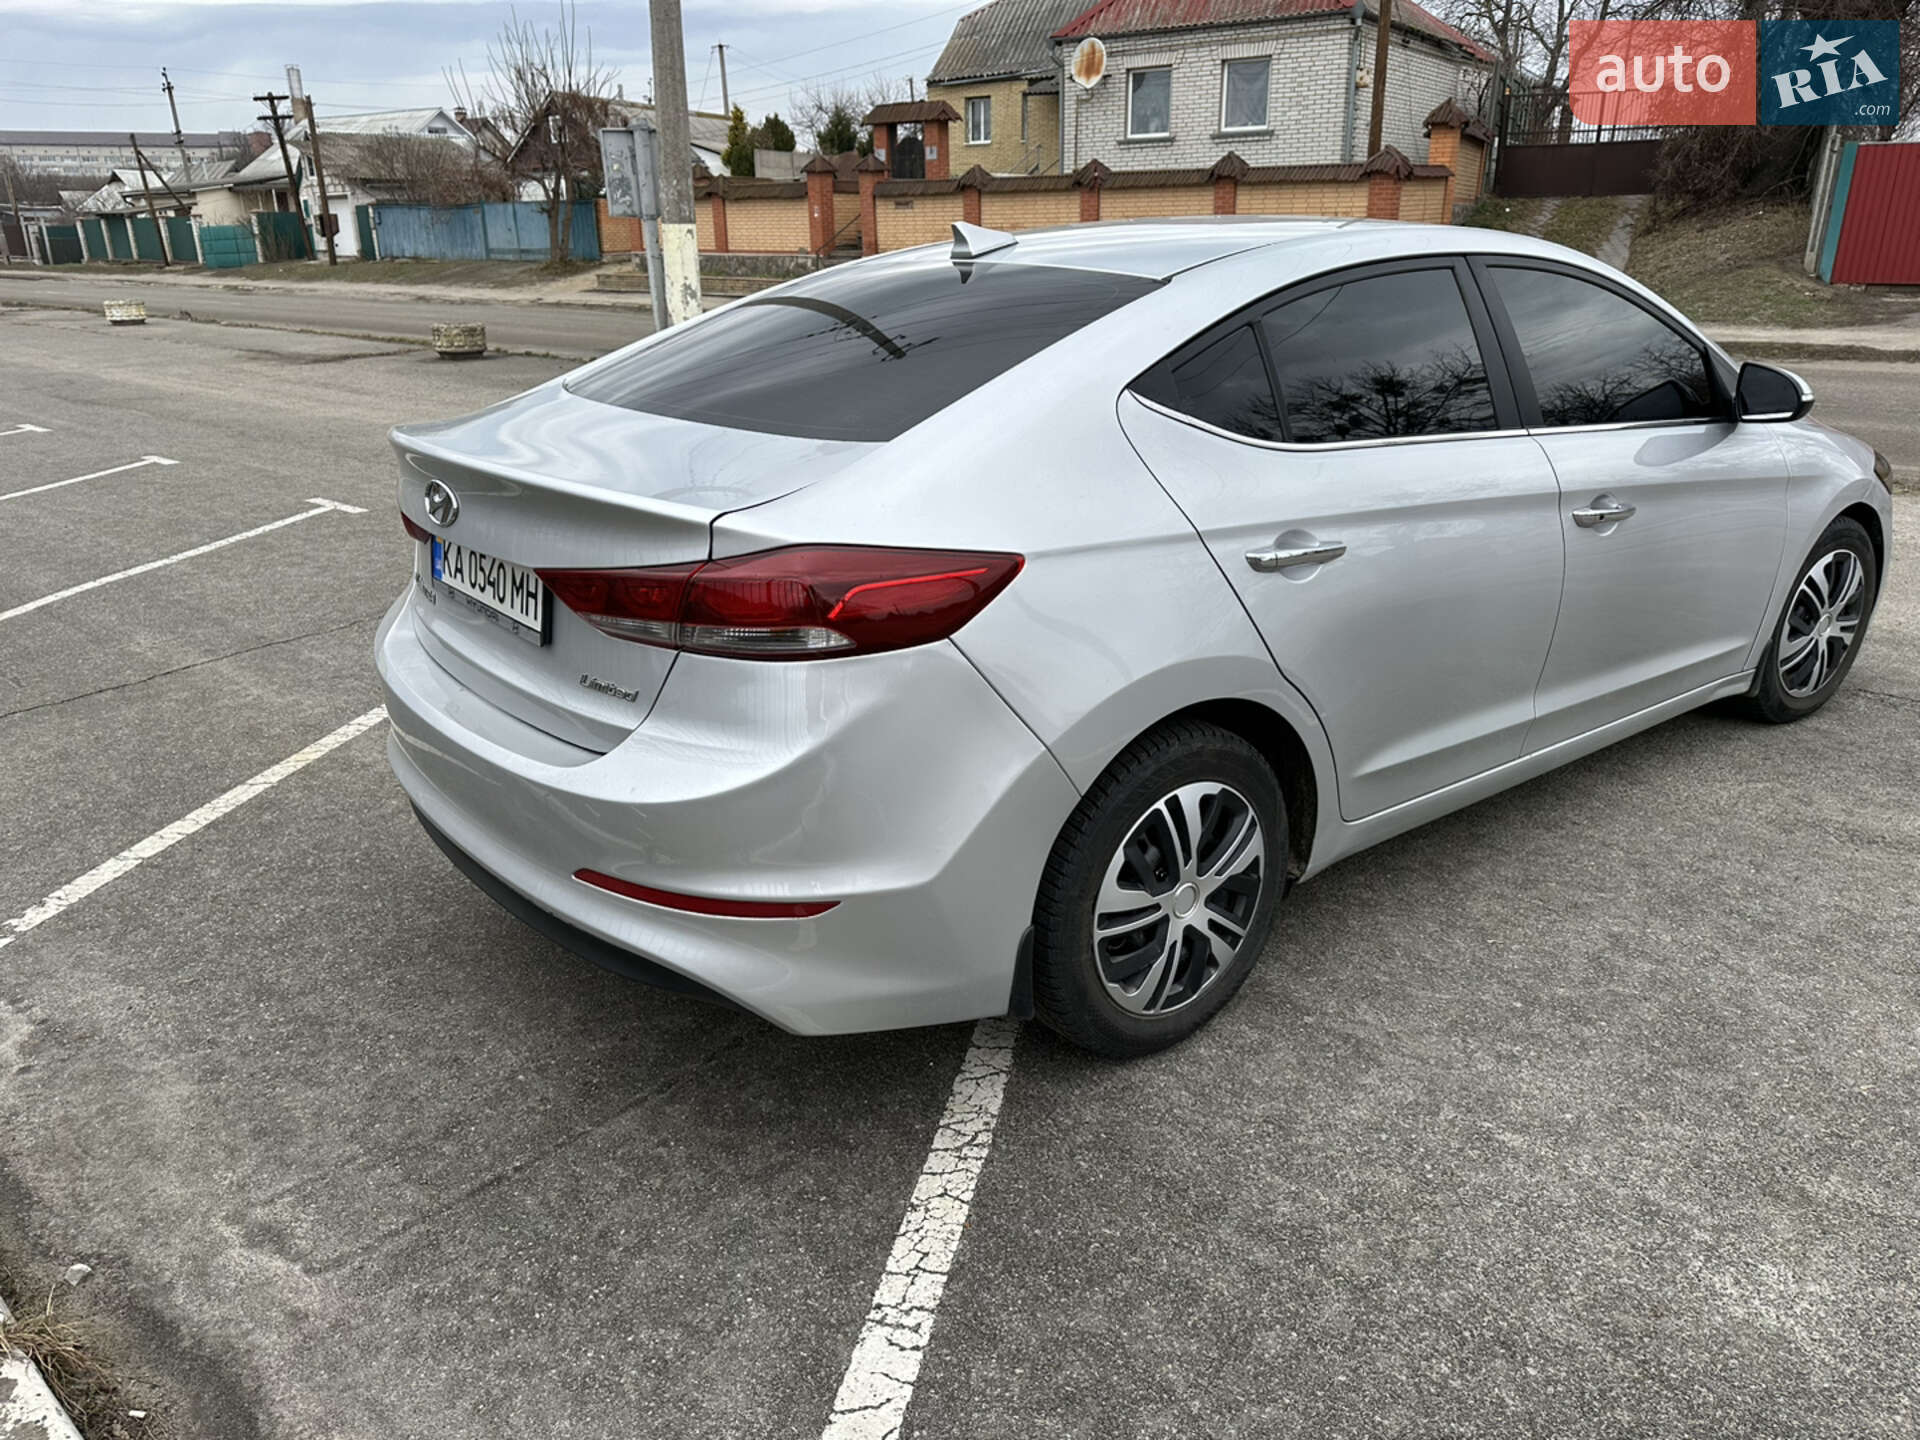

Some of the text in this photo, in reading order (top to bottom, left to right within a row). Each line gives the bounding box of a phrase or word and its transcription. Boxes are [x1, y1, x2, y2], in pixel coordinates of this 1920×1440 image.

[443, 540, 465, 584] KA
[468, 549, 507, 605] 0540
[510, 566, 539, 621] MH
[579, 673, 640, 703] Limited
